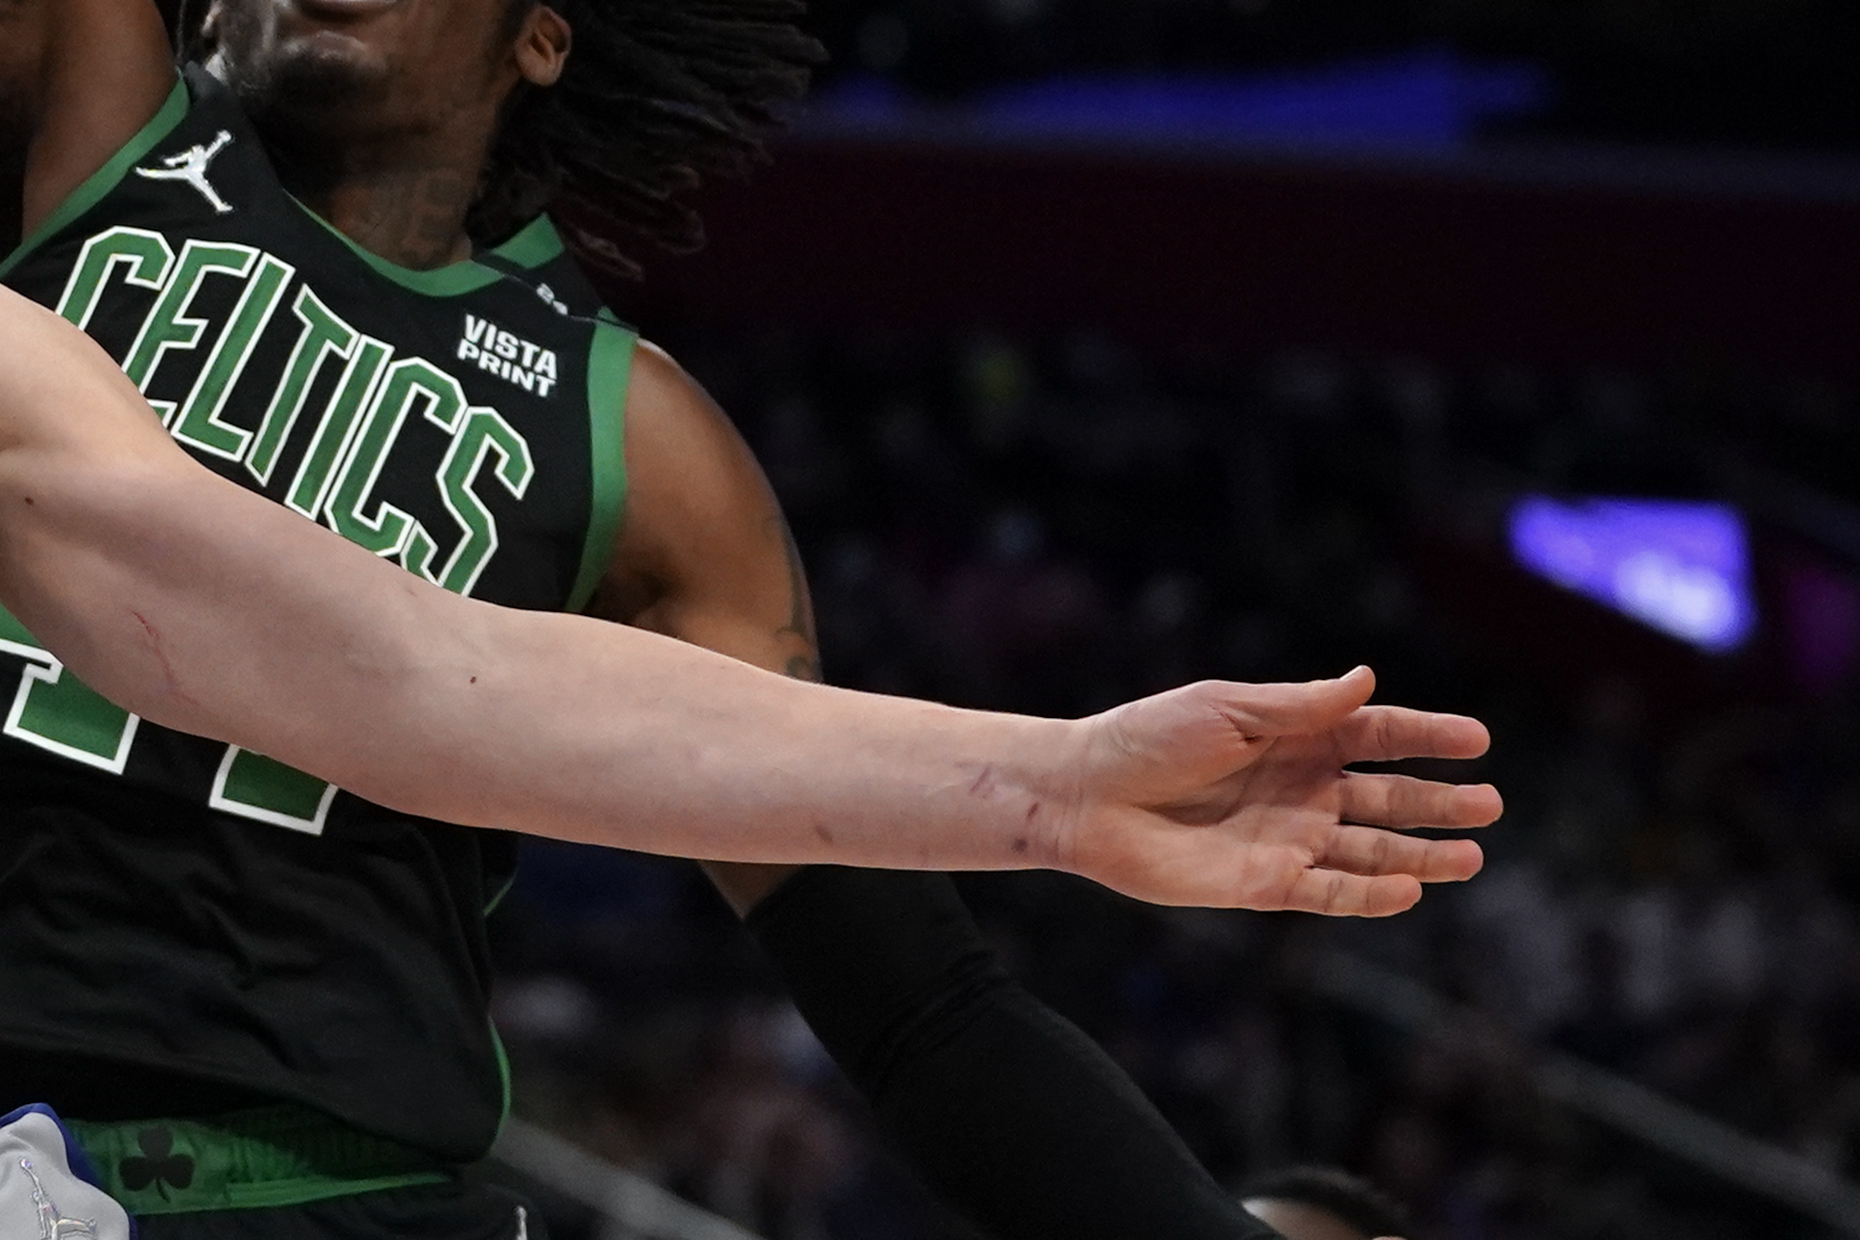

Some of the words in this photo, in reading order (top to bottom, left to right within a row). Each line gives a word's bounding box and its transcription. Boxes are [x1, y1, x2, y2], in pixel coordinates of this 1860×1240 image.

[457, 338, 557, 398] PRINT
[465, 313, 558, 381] VISTA
[55, 225, 535, 598] CELTICS
